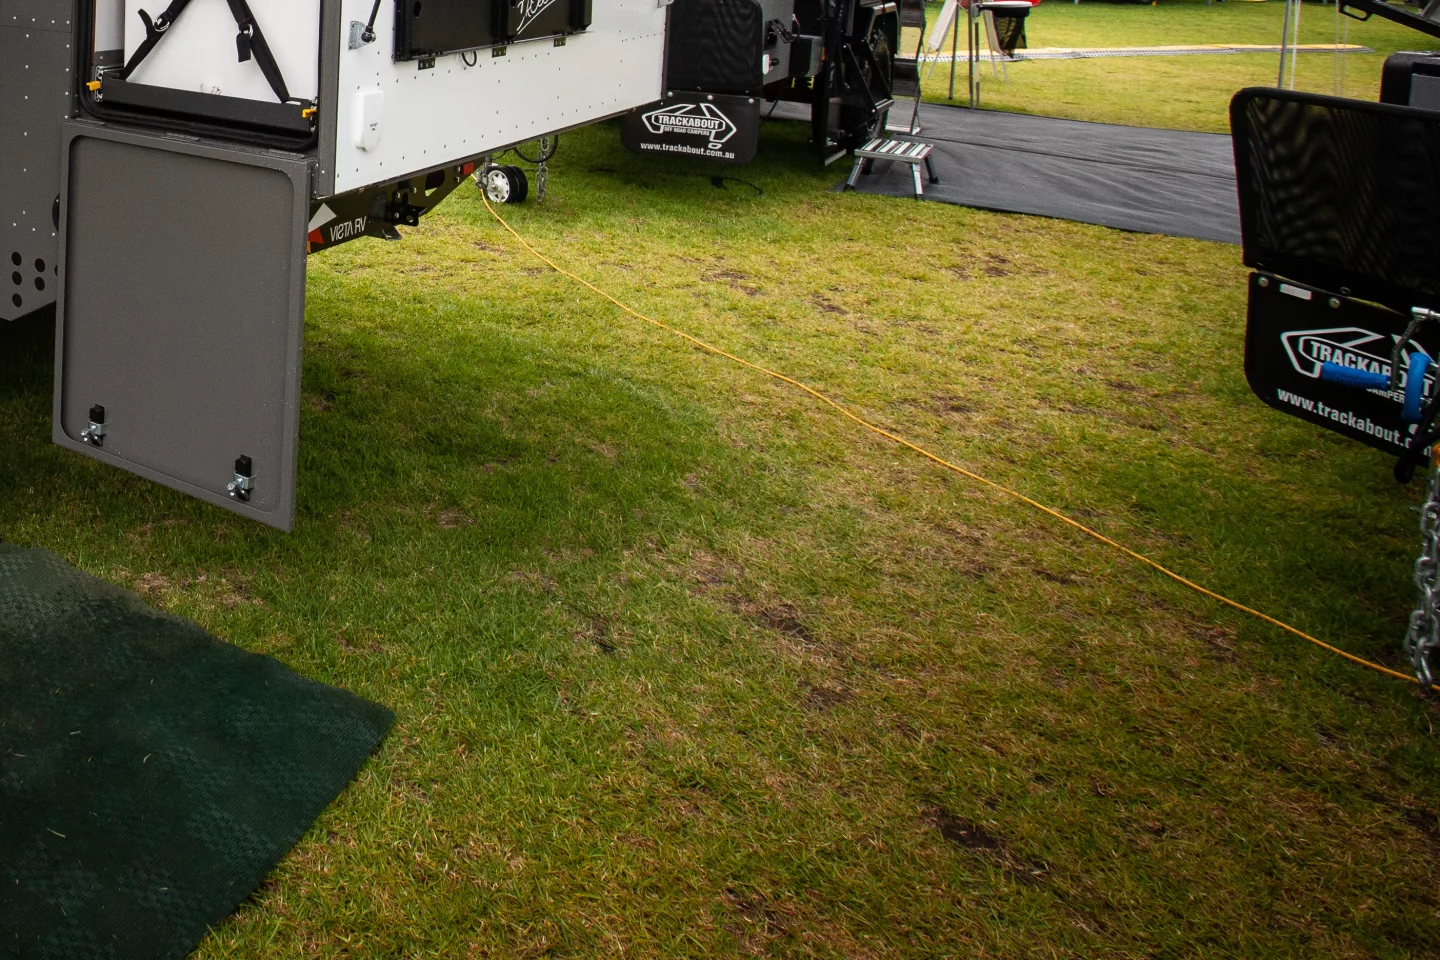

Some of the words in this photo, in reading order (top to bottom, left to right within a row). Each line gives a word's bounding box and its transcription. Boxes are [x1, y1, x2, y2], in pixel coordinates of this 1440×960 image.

[658, 115, 719, 129] TRACKABOUT
[664, 125, 672, 133] OFF
[686, 128, 710, 136] CAMPERS
[640, 142, 735, 158] www.trackabout.com.au
[354, 215, 367, 234] RV
[1310, 341, 1433, 397] TRACKABT
[1277, 388, 1432, 457] www.trackabout.c
